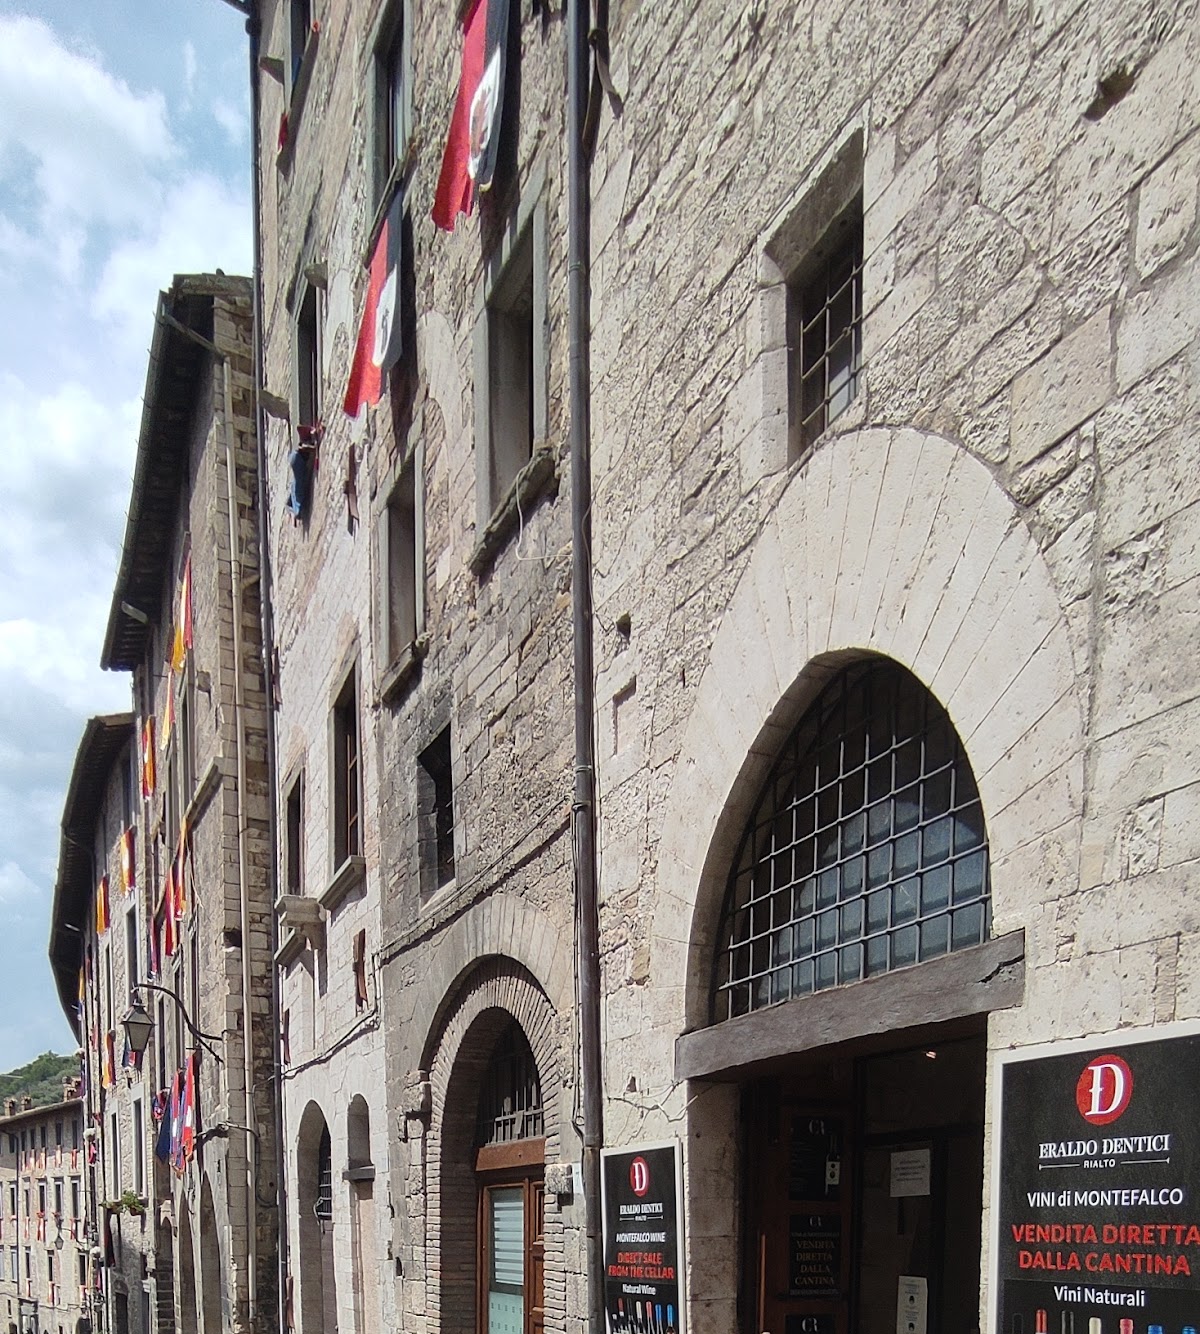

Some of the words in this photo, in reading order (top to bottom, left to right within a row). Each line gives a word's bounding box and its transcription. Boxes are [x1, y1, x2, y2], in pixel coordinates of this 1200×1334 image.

[1039, 1139, 1097, 1158] ERALDO
[1102, 1134, 1170, 1155] DENTICI
[1083, 1159, 1115, 1168] RIALTO
[1027, 1191, 1055, 1208] VINI
[1058, 1190, 1071, 1207] di
[1074, 1188, 1183, 1207] MONTEFALCO
[620, 1205, 640, 1215] ERALDO
[616, 1232, 649, 1243] MONTEFALCO
[650, 1232, 666, 1242] WINE
[1011, 1223, 1097, 1243] VENDITA
[1102, 1223, 1200, 1246] DIRETTA
[617, 1253, 642, 1264] DIRECT
[643, 1253, 662, 1264] SALE
[796, 1252, 832, 1262] DIRETTA
[800, 1264, 830, 1273] DALLA
[1019, 1250, 1081, 1271] DALLA
[1085, 1252, 1191, 1276] CANTINA
[608, 1265, 628, 1276] FROM
[630, 1266, 642, 1277] THE
[644, 1266, 674, 1279] CELLAR
[794, 1275, 834, 1285] CANTINA
[622, 1284, 641, 1294] Natural
[641, 1285, 656, 1295] Wine
[1054, 1285, 1080, 1302] Vini
[1084, 1288, 1145, 1307] Naturali
